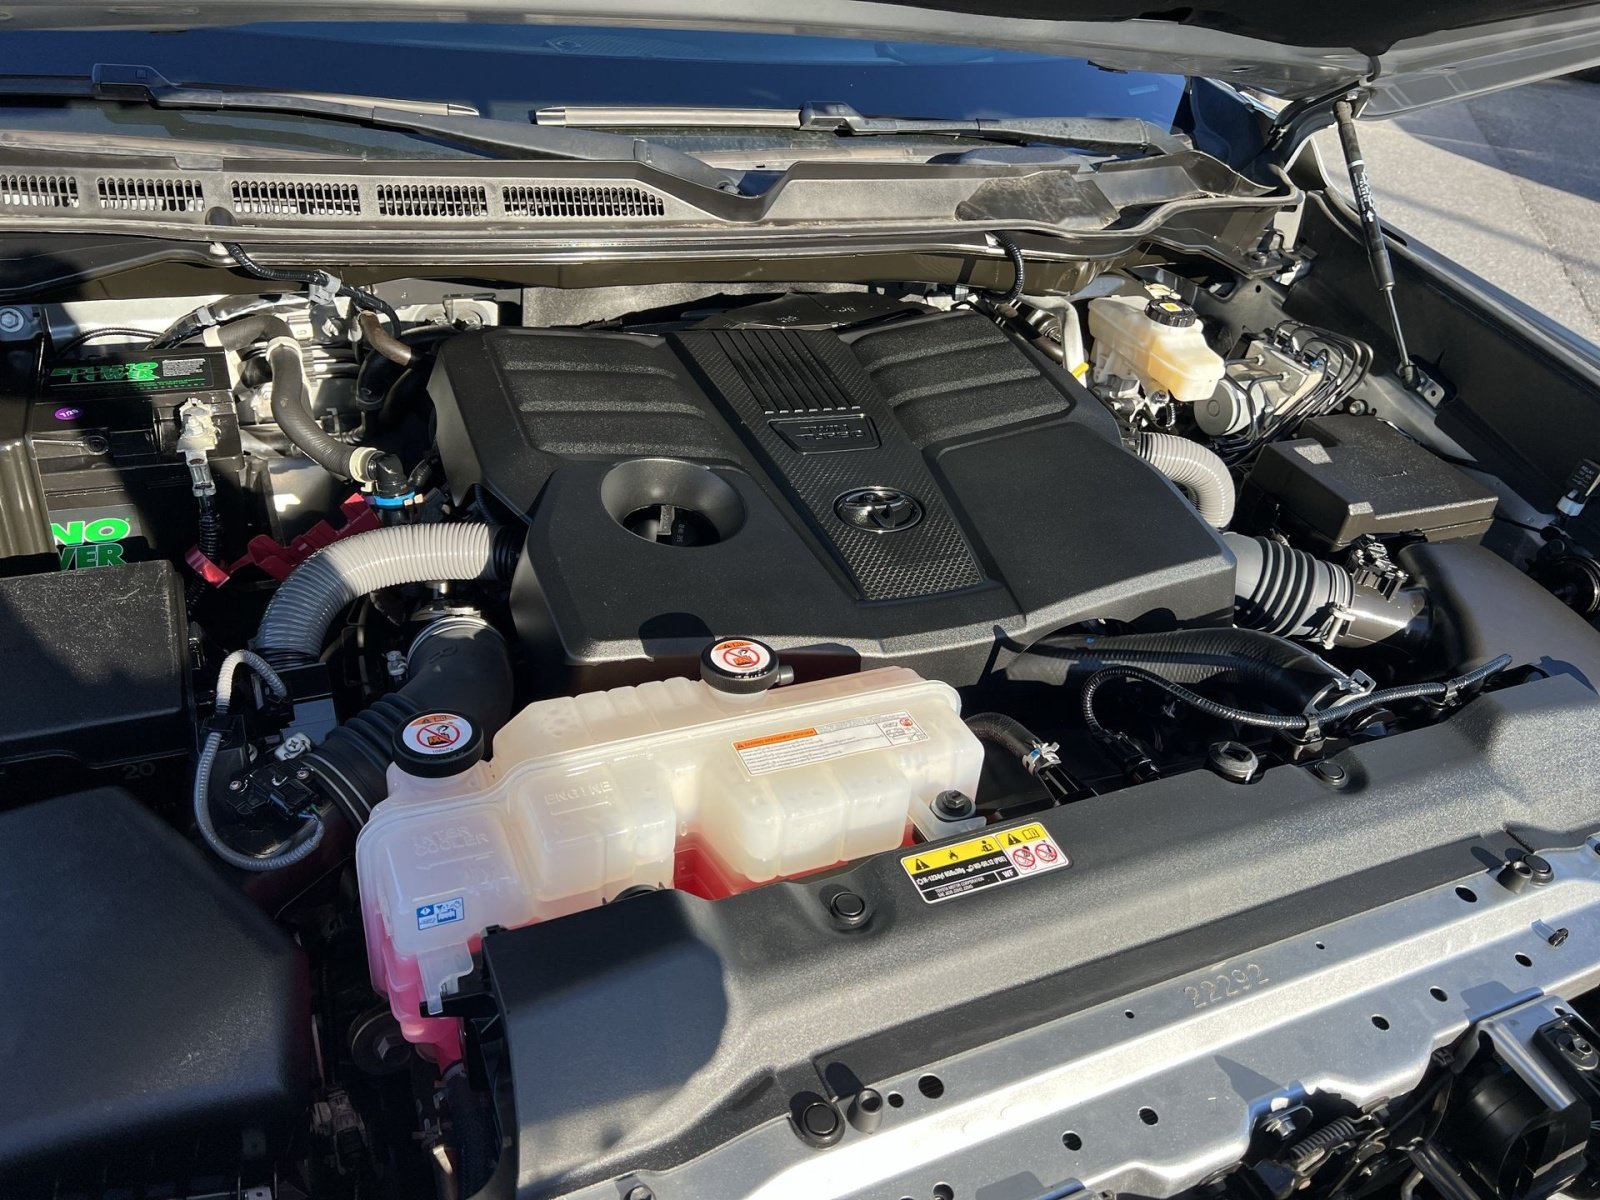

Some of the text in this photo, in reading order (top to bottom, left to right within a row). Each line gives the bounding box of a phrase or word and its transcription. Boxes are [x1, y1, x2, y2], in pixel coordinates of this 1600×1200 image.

[121, 761, 156, 779] 20
[544, 781, 614, 806] ENGINE
[415, 833, 489, 857] COOLER
[1001, 869, 1014, 878] WF
[1183, 963, 1270, 1009] 22292
